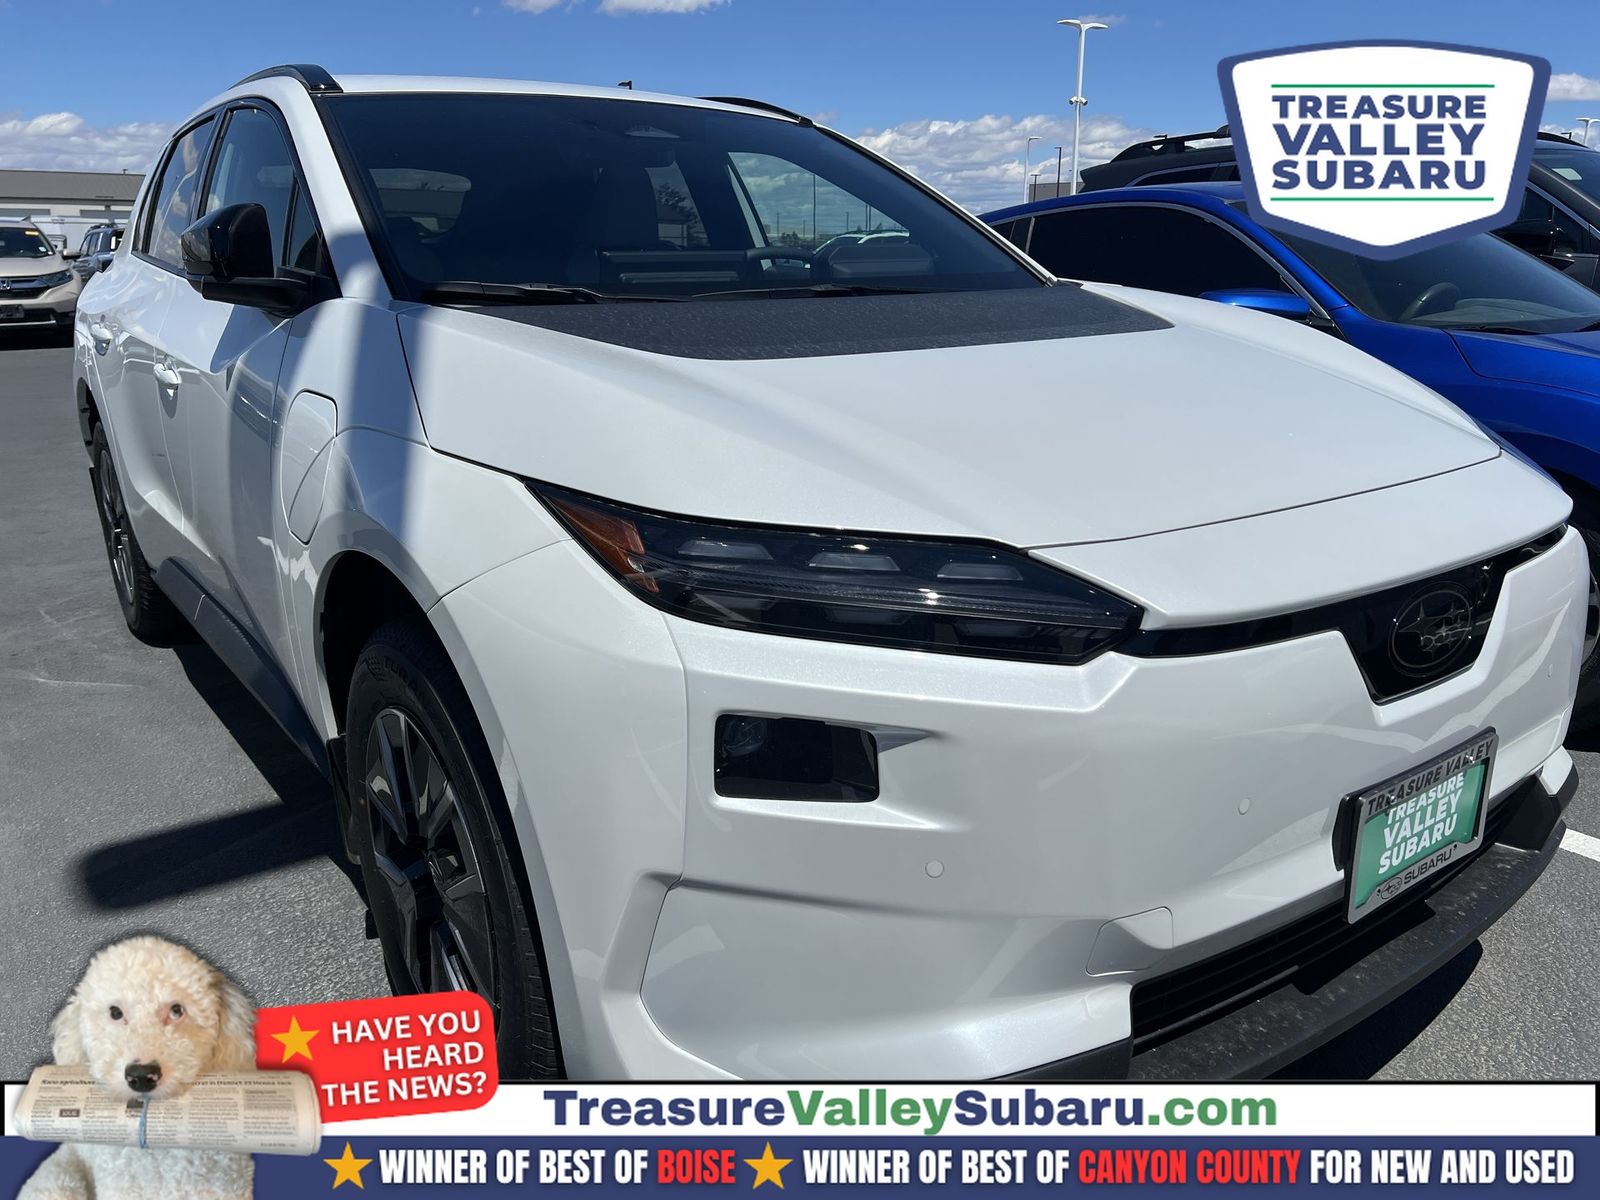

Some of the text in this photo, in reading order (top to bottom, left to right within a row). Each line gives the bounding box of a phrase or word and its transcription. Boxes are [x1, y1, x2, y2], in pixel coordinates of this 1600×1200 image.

[1368, 740, 1493, 816] TREASURE VALLEY
[1387, 772, 1465, 825] TREASURE
[1378, 814, 1458, 874] SUBARU
[1383, 790, 1462, 848] VALLEY
[1403, 849, 1452, 883] SUBARU
